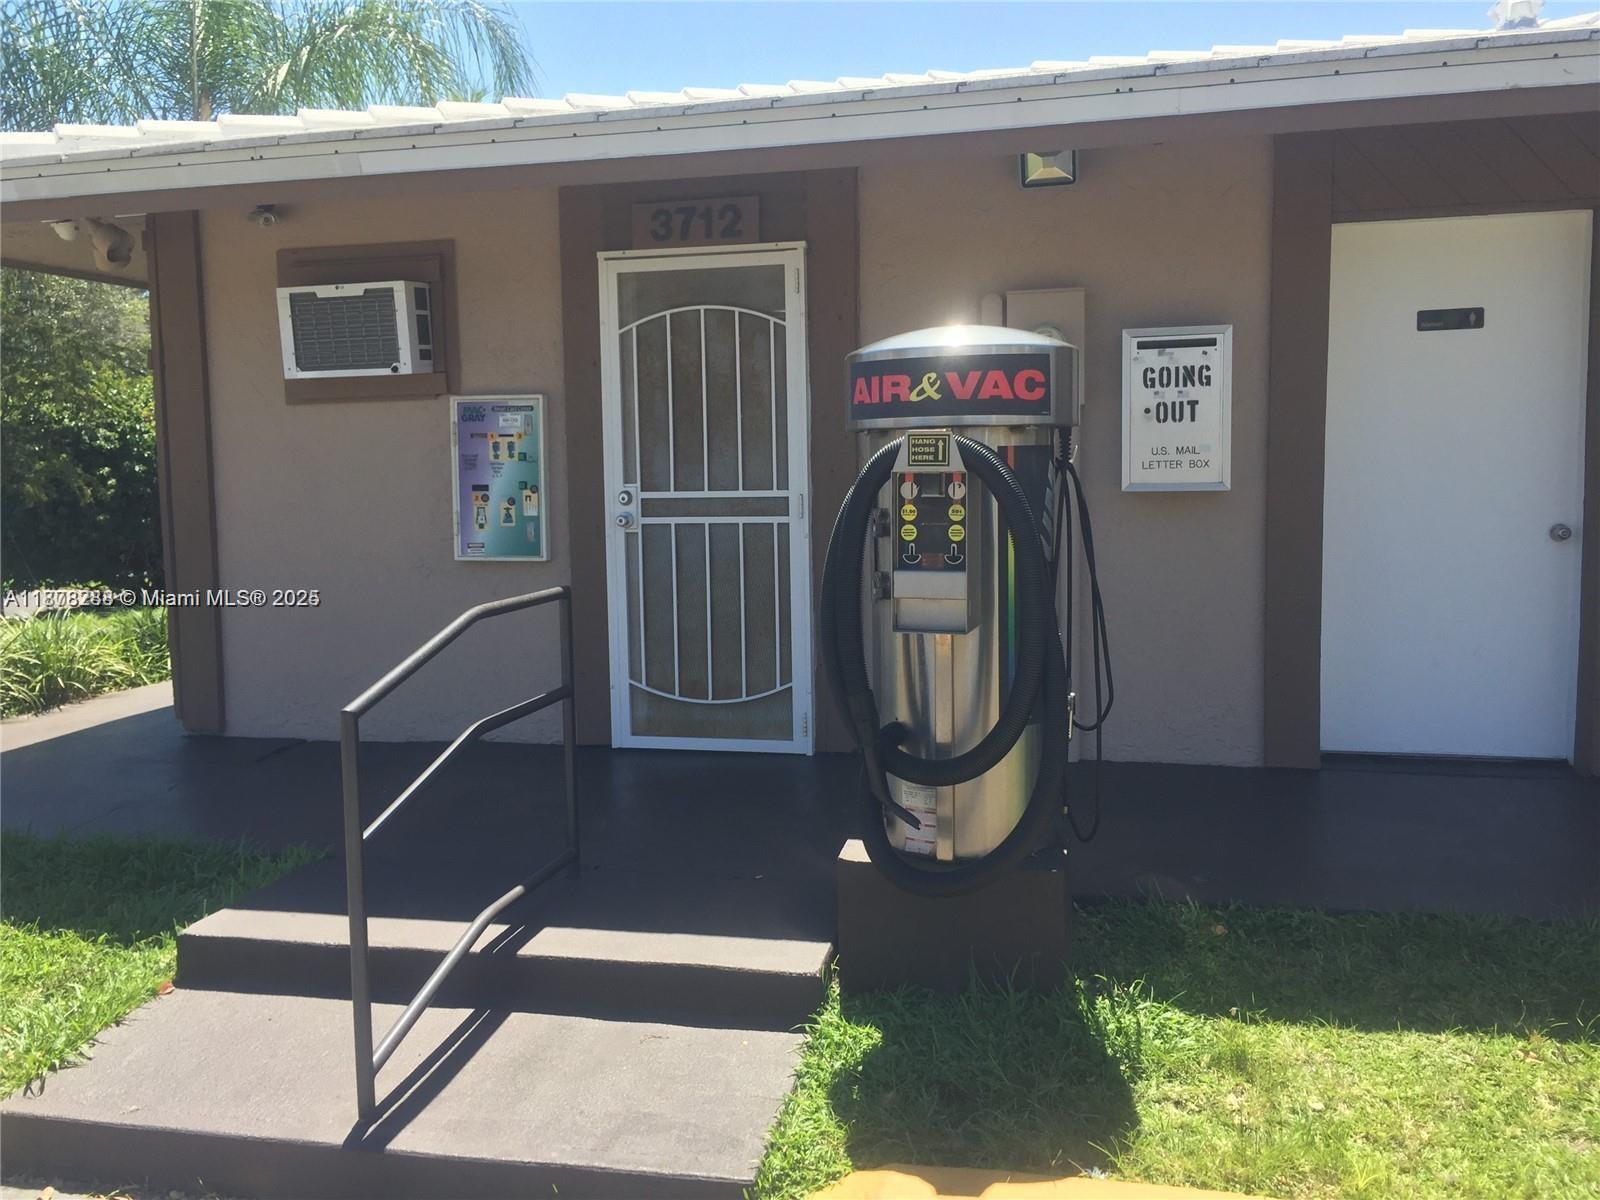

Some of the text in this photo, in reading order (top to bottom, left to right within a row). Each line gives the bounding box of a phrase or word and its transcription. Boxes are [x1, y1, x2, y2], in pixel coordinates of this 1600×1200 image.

[650, 203, 743, 241] 3712
[853, 374, 912, 405] AIR
[944, 369, 1047, 401] VAC
[1142, 364, 1212, 389] GOING
[1155, 400, 1200, 424] OUT
[1151, 446, 1201, 456] U.S. MAIL
[1141, 459, 1210, 470] LETTER BOX
